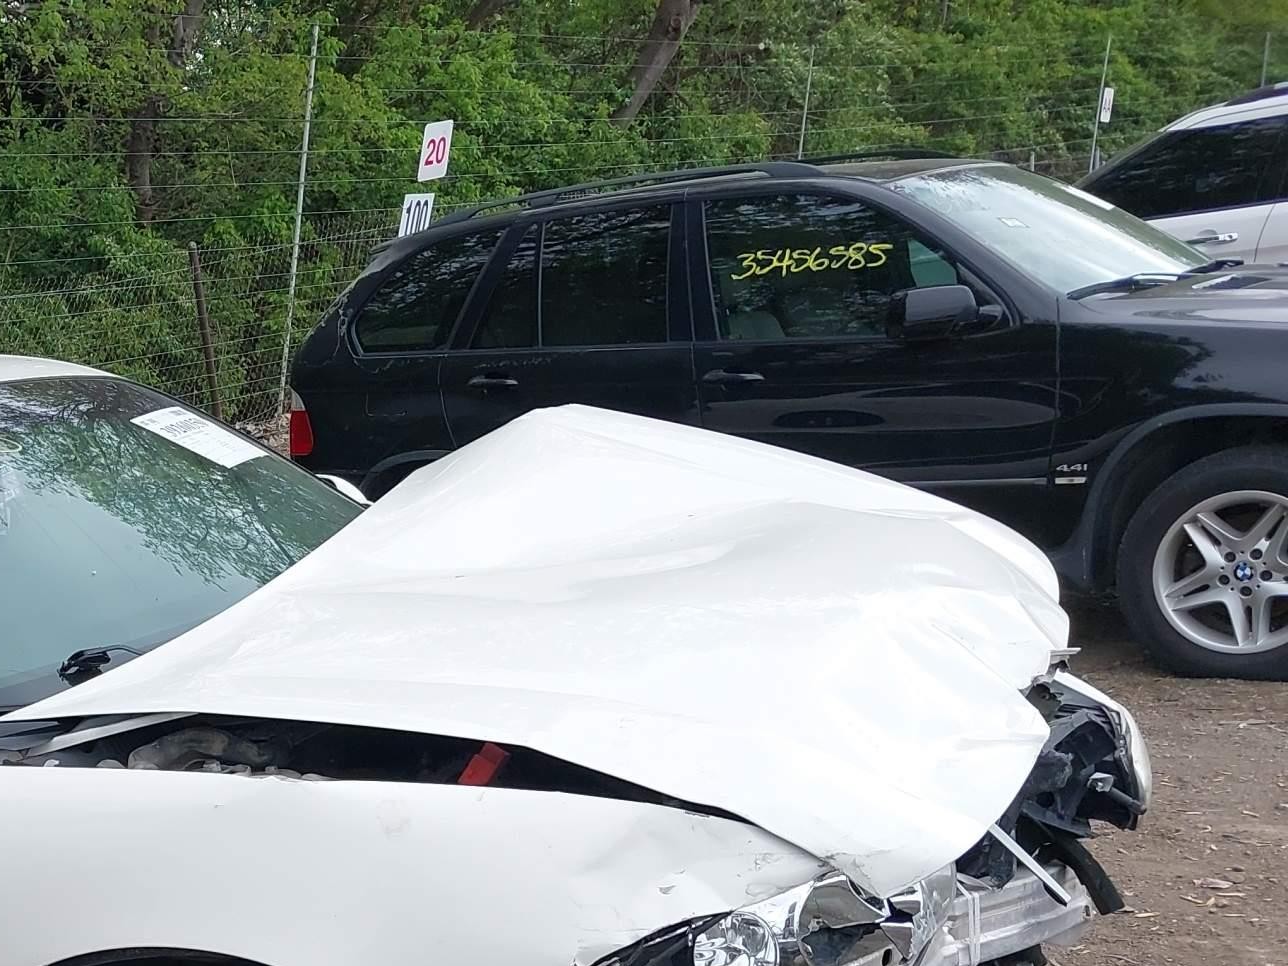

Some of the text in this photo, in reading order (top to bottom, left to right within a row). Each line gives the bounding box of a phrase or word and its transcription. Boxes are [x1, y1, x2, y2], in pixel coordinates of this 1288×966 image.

[423, 136, 447, 167] 20
[404, 199, 429, 236] 100
[730, 242, 894, 281] 35456585
